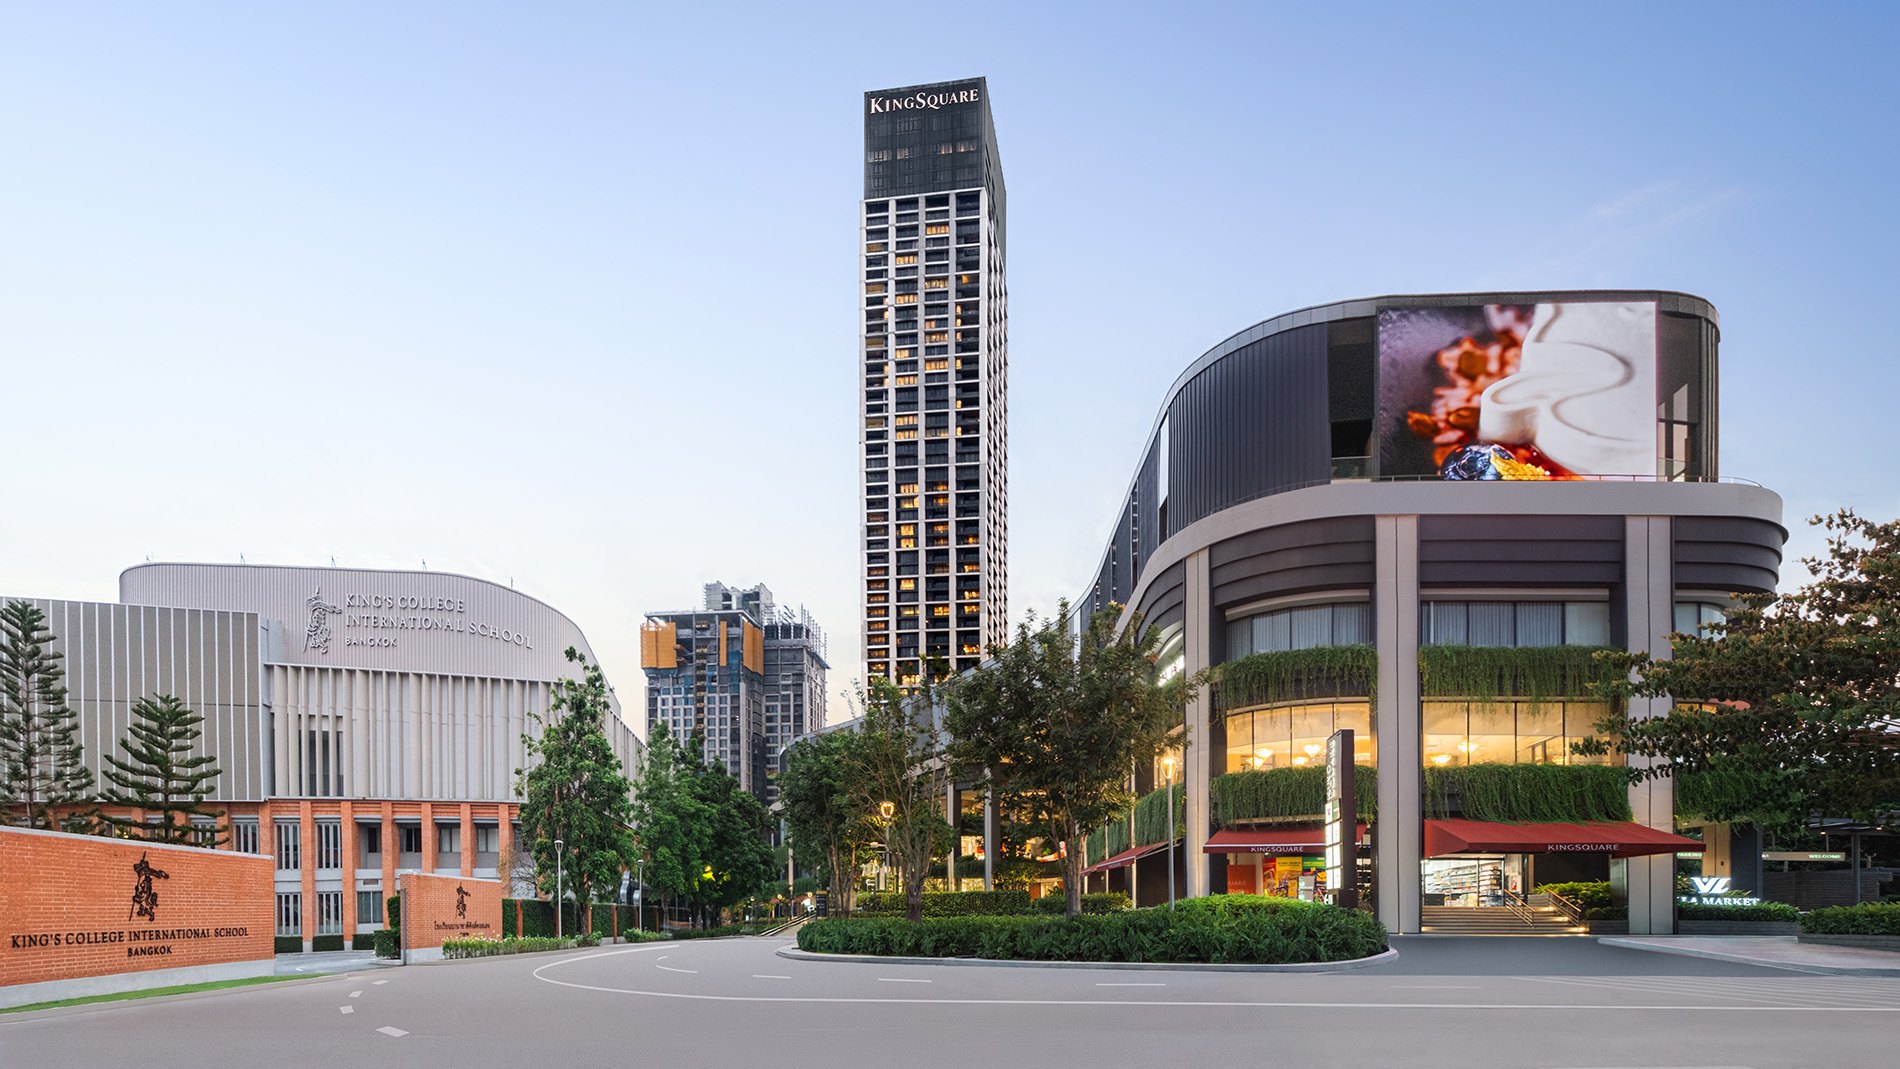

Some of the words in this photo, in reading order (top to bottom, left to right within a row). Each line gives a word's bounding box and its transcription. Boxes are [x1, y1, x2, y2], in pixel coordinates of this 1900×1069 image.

[870, 88, 979, 114] KINGSQUARE
[345, 594, 394, 608] KING'S
[398, 596, 465, 613] COLLEGE
[345, 615, 464, 632] INTERNATIONAL
[469, 622, 534, 649] SCHOOL
[345, 637, 397, 647] BANGKOK
[1702, 897, 1760, 906] MARKET
[11, 933, 61, 949] KING'S
[65, 932, 124, 945] COLLEGE
[128, 928, 211, 941] INTERNATIONAL
[214, 927, 249, 937] SCHOOL
[127, 946, 172, 957] BANGKOK
